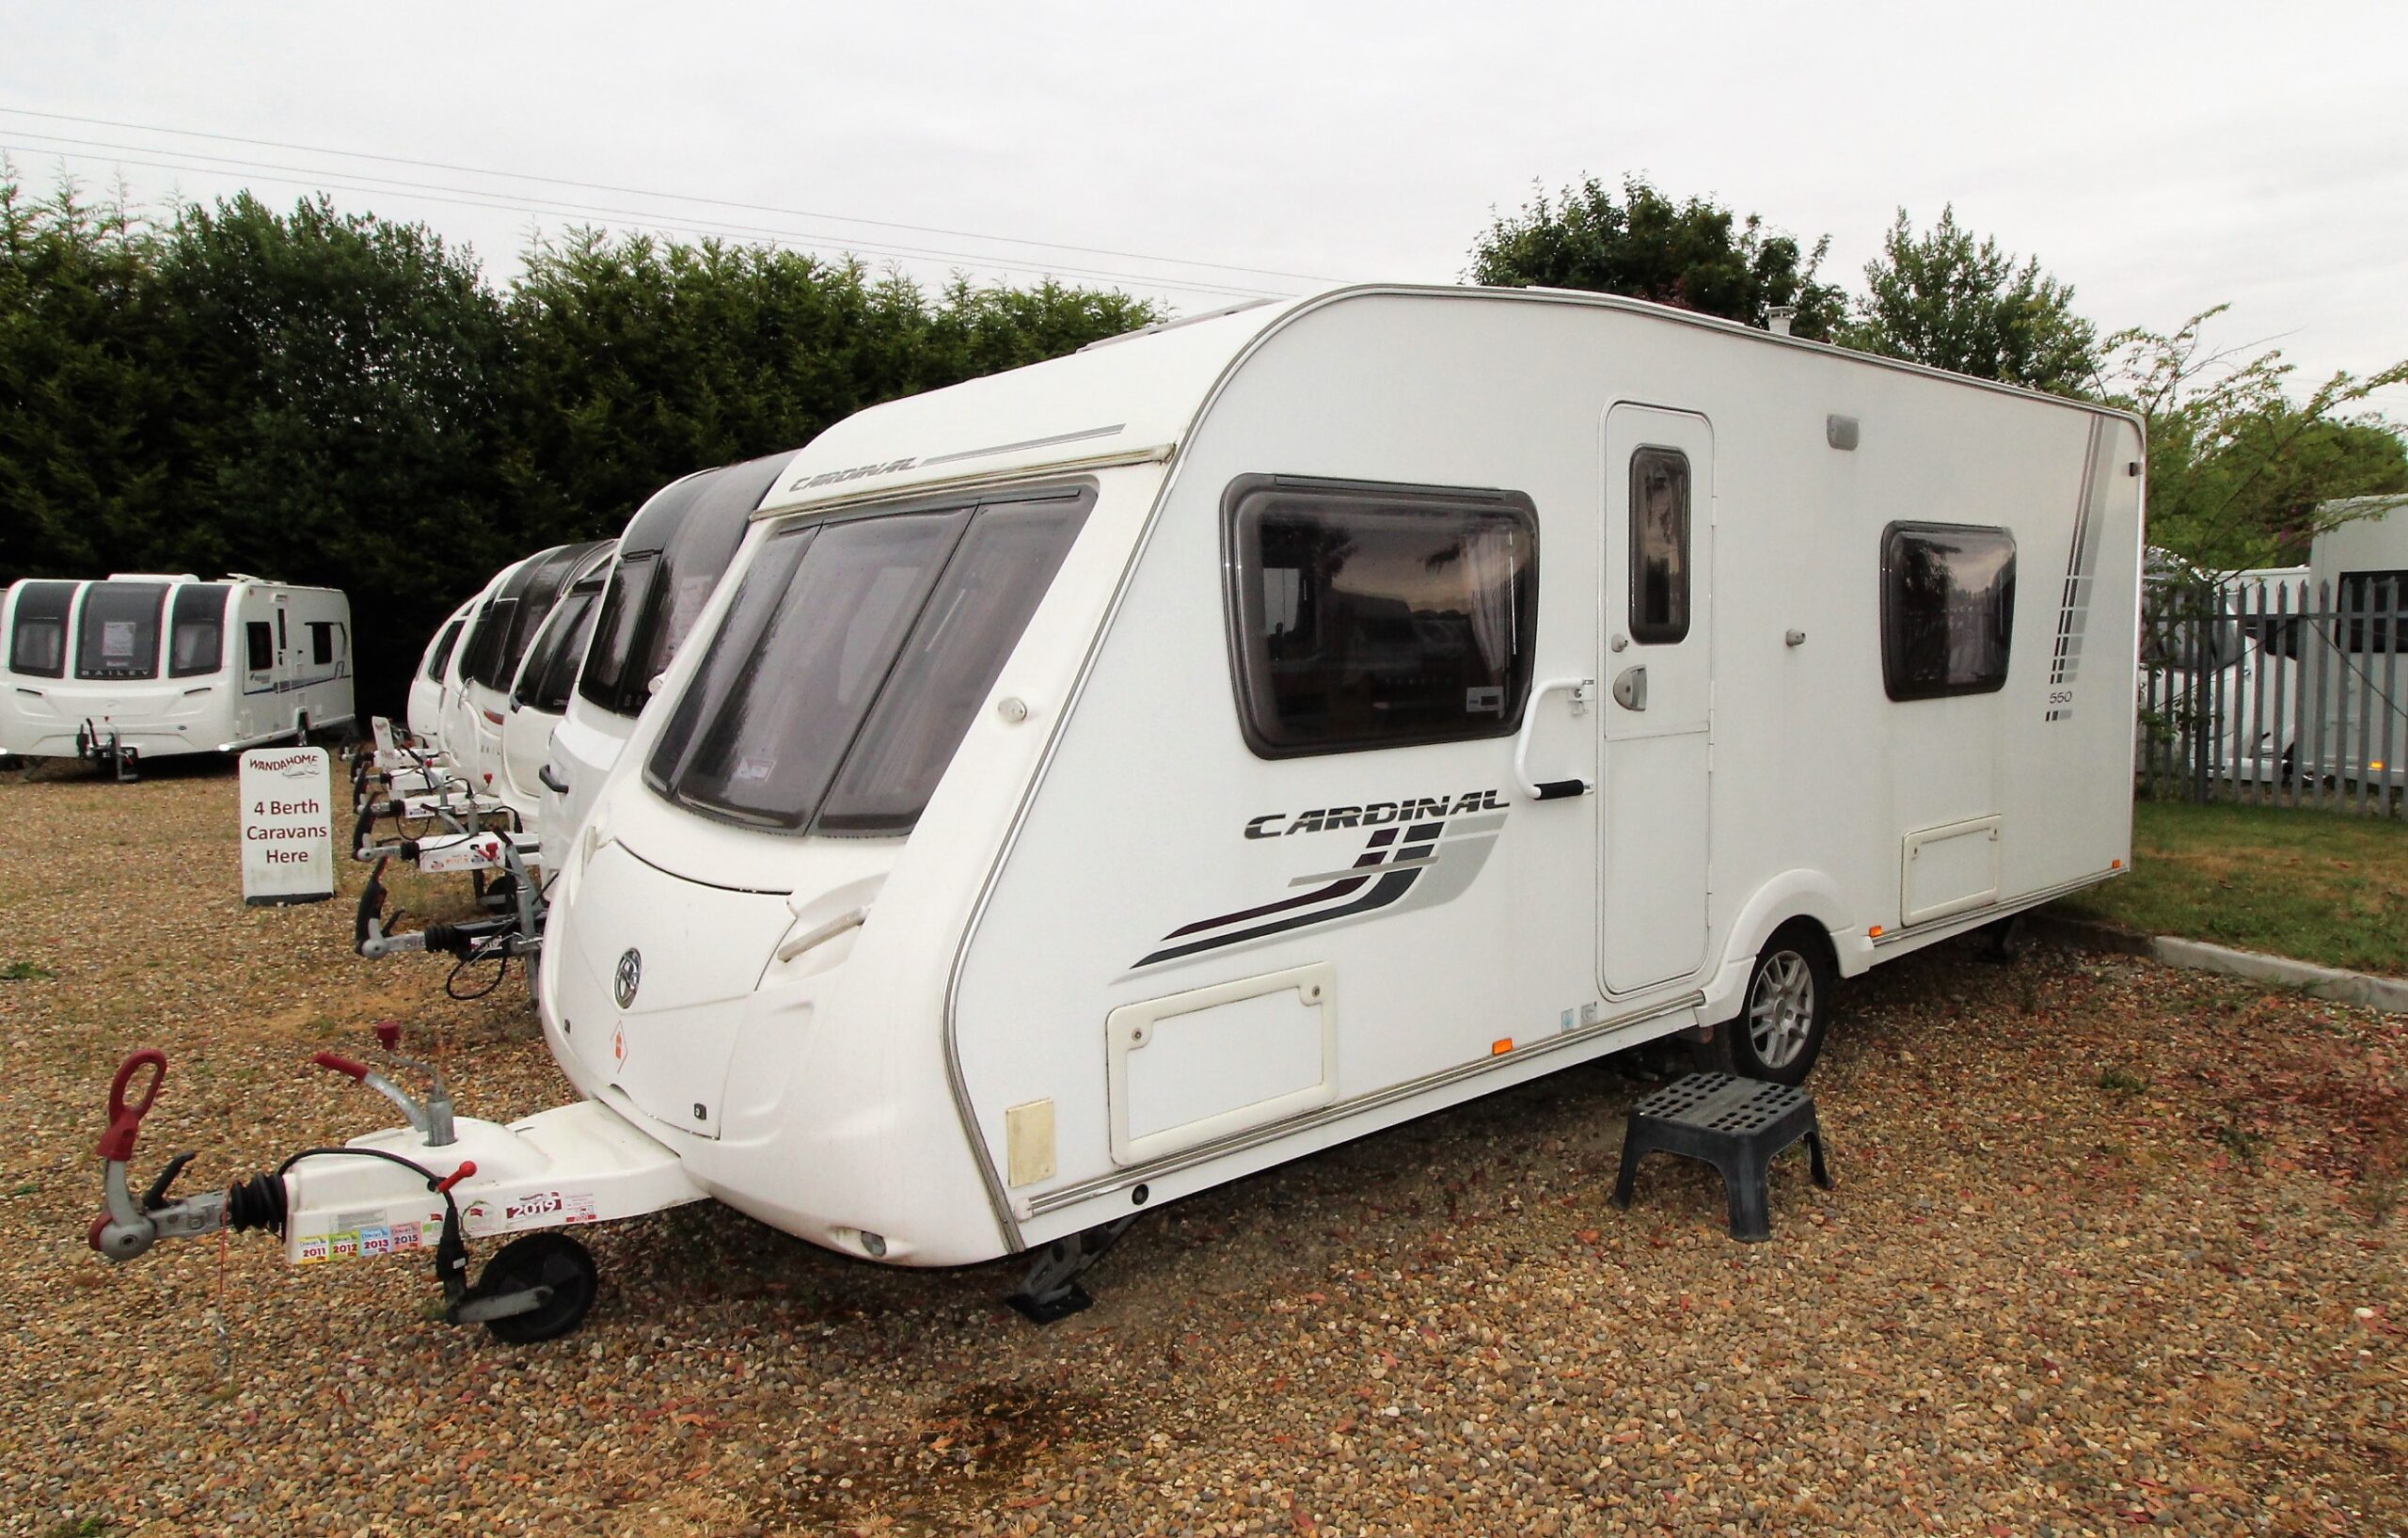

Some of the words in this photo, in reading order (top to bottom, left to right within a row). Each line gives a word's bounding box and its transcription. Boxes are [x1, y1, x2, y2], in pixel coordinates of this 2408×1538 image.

[789, 457, 917, 492] CARDINAL
[2050, 691, 2072, 704] 550
[249, 754, 319, 770] WANDAHOME
[254, 801, 264, 816] 4
[271, 799, 319, 816] Berth
[1244, 789, 1511, 839] CARDINAL
[246, 826, 327, 840] Caravans
[266, 849, 309, 864] Here
[512, 1199, 557, 1218] 2019
[364, 1239, 389, 1249] 2013
[393, 1234, 419, 1245] 2015
[303, 1247, 326, 1258] 2011
[333, 1244, 357, 1254] 2012
